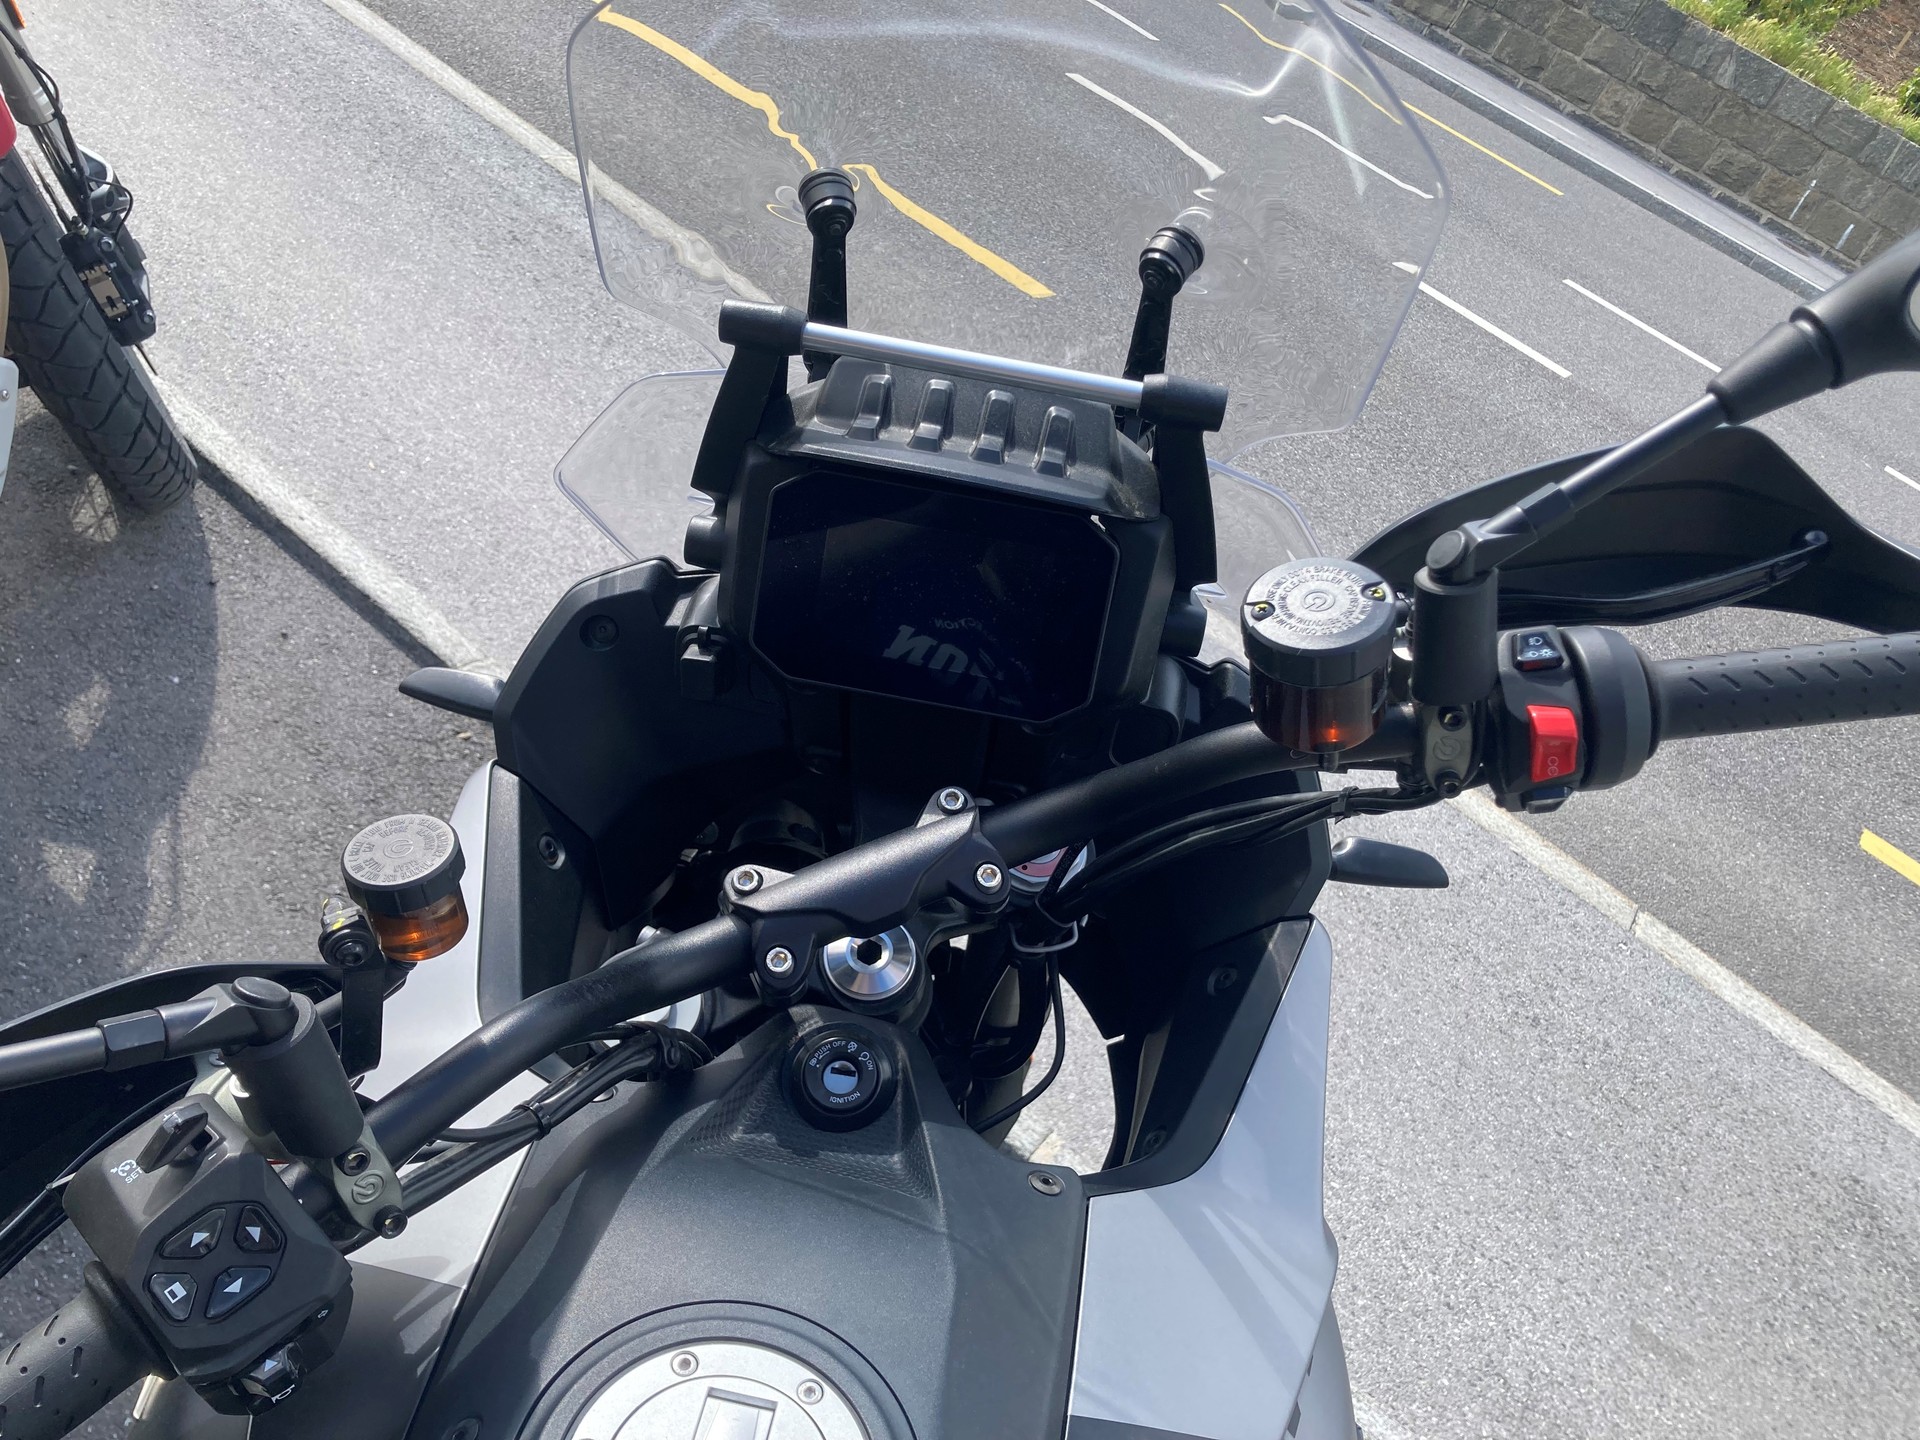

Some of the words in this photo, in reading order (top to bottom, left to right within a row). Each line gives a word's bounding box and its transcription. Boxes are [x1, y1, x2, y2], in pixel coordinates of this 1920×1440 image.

[1314, 566, 1343, 576] BRAKE
[815, 1044, 831, 1058] PUSH
[866, 1060, 874, 1070] ON
[830, 1091, 861, 1103] IGNITION
[125, 1166, 143, 1184] SET
